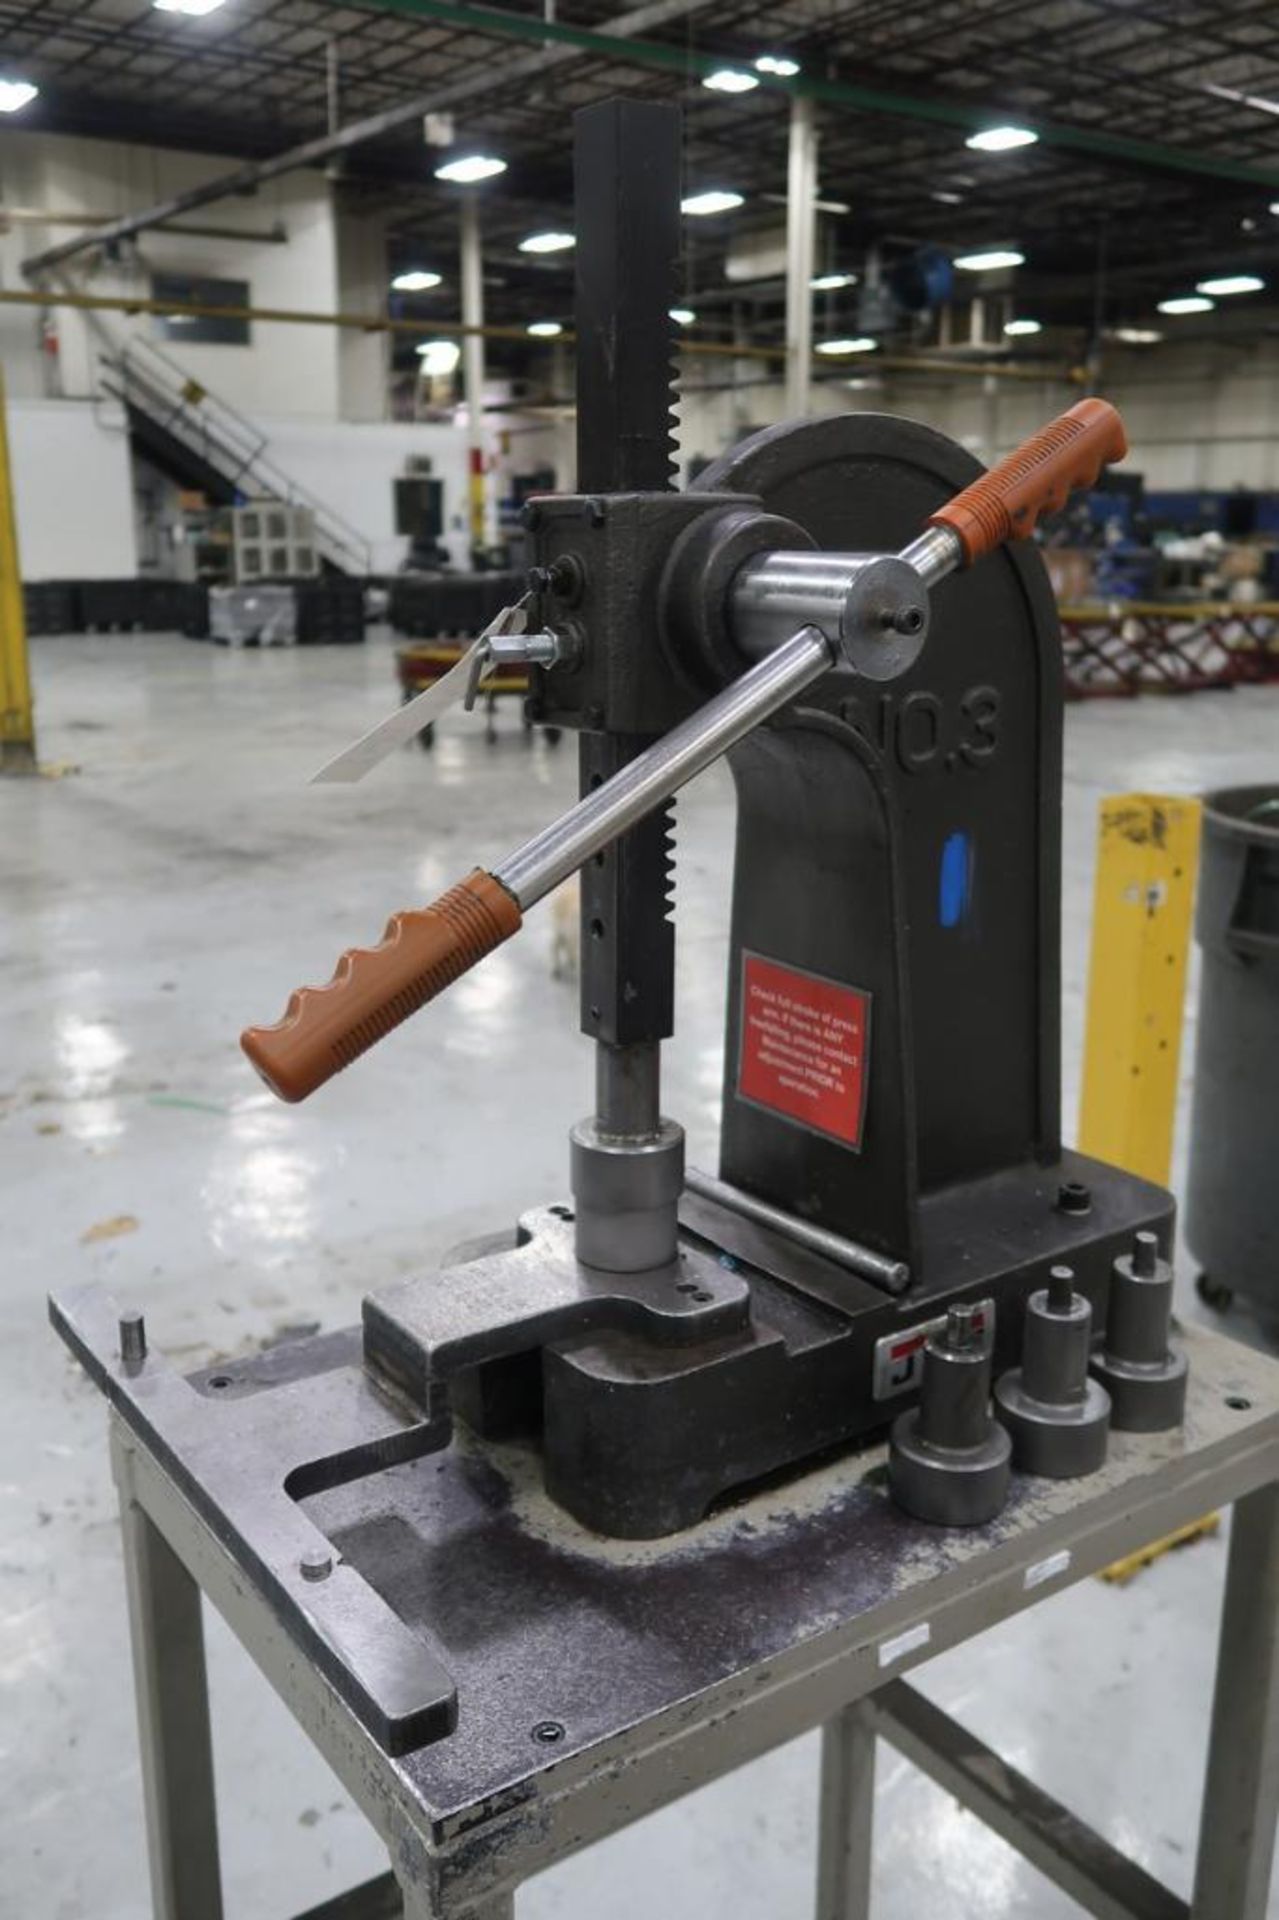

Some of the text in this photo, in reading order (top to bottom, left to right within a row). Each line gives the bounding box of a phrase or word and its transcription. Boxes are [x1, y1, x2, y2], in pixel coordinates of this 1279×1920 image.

[789, 1015, 811, 1032] there
[823, 1028, 844, 1043] ANY
[821, 1012, 831, 1024] of
[832, 1017, 859, 1034] press
[793, 1034, 822, 1053] please
[823, 1046, 858, 1066] contact
[815, 1055, 829, 1070] for
[830, 1064, 842, 1076] an
[804, 1067, 834, 1089] PRIOR
